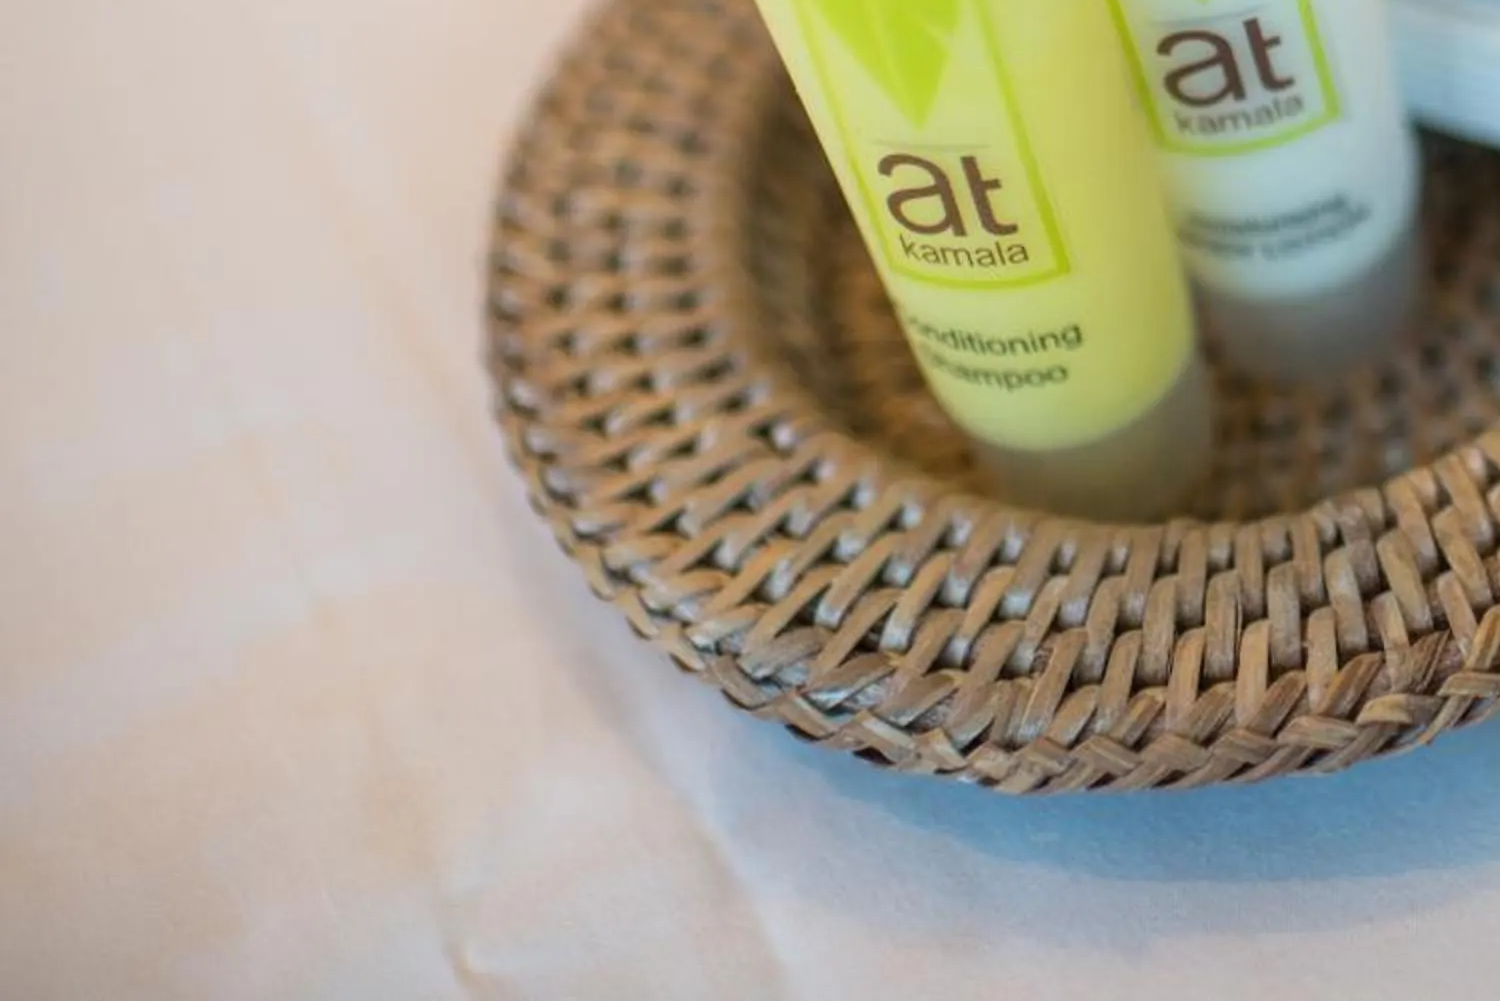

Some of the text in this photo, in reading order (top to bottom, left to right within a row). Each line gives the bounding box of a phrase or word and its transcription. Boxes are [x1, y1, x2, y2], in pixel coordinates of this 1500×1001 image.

[1156, 17, 1295, 108] at
[1173, 95, 1304, 136] kamala
[878, 152, 1018, 237] at
[899, 233, 1029, 267] kamala
